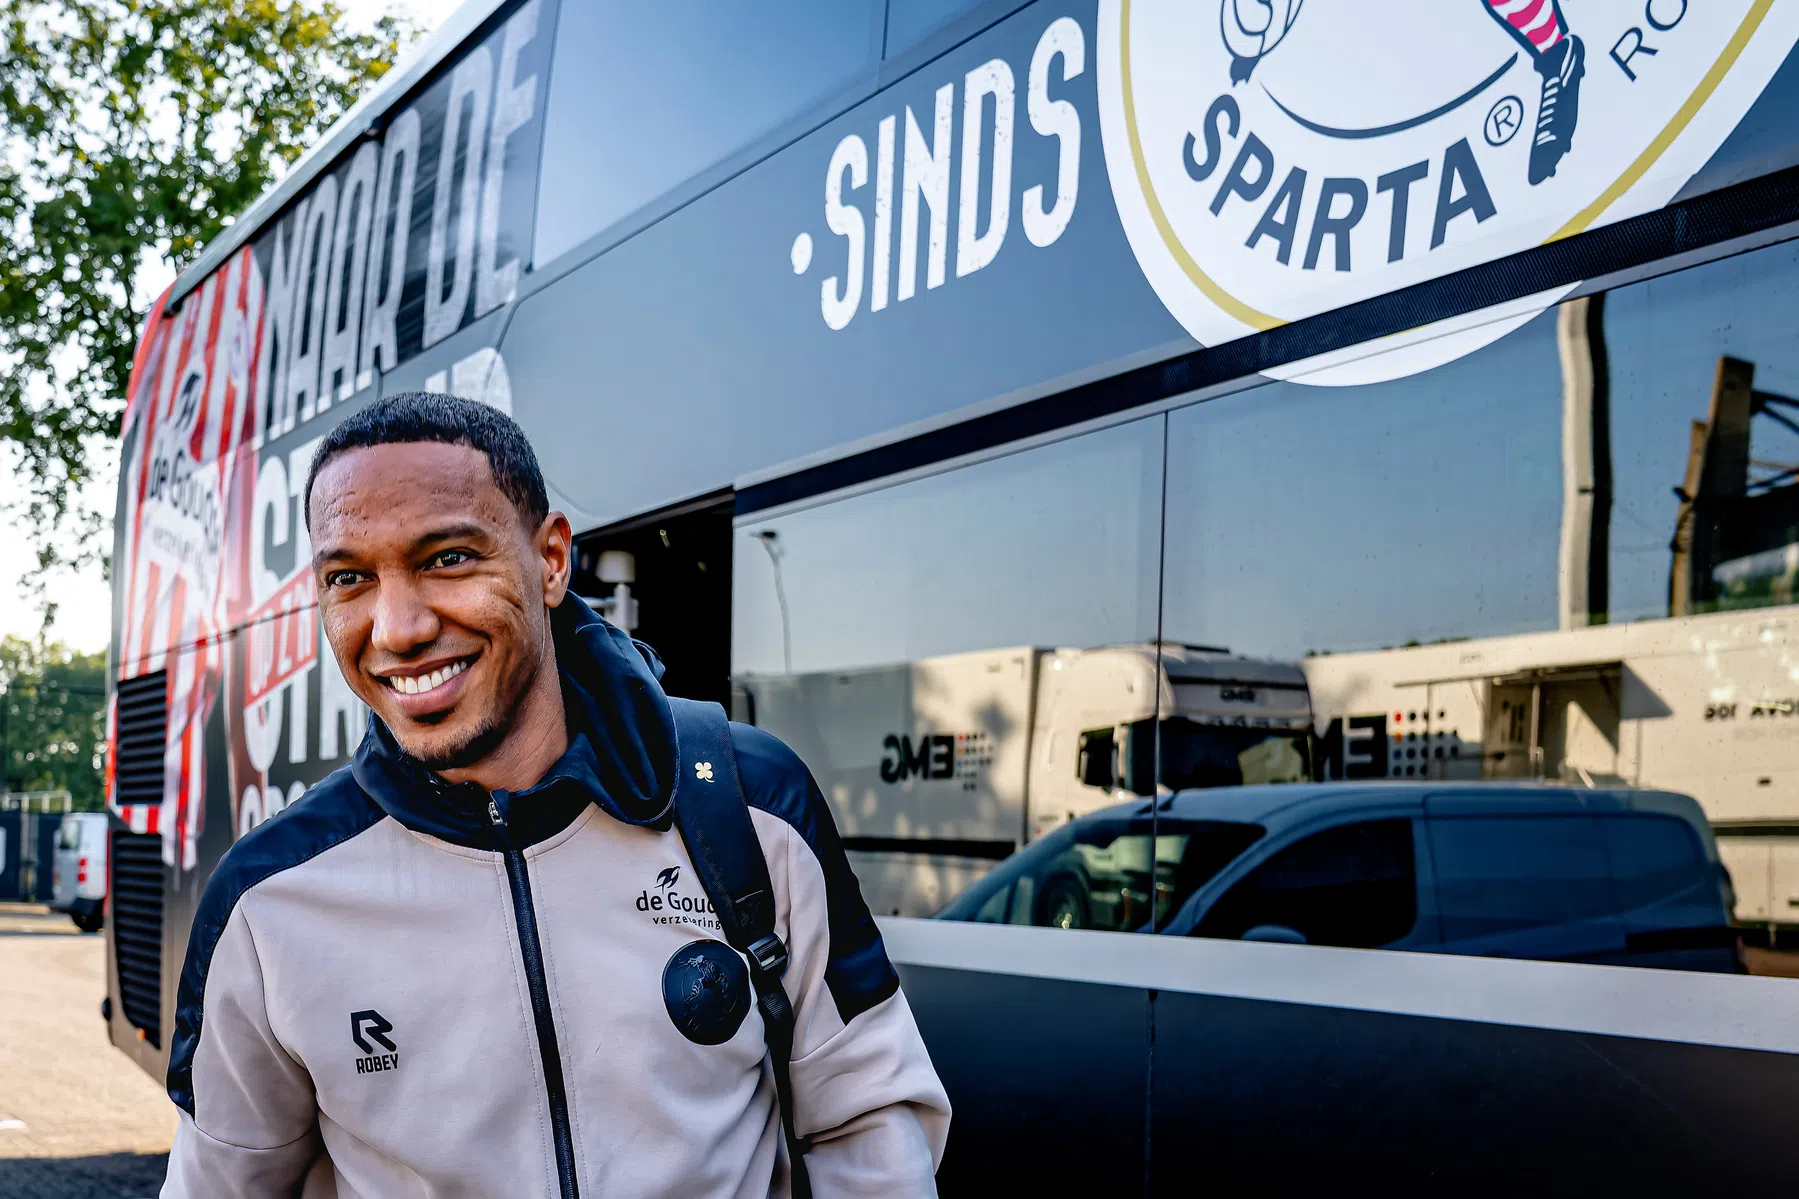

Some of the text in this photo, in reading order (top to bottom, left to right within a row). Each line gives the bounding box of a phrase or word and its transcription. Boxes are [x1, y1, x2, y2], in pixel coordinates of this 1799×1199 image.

[253, 0, 538, 450] NAAR DE
[821, 16, 1085, 331] SINDS
[1183, 93, 1498, 273] SPARTA
[636, 890, 663, 911] de
[356, 1053, 398, 1074] ROBEY
